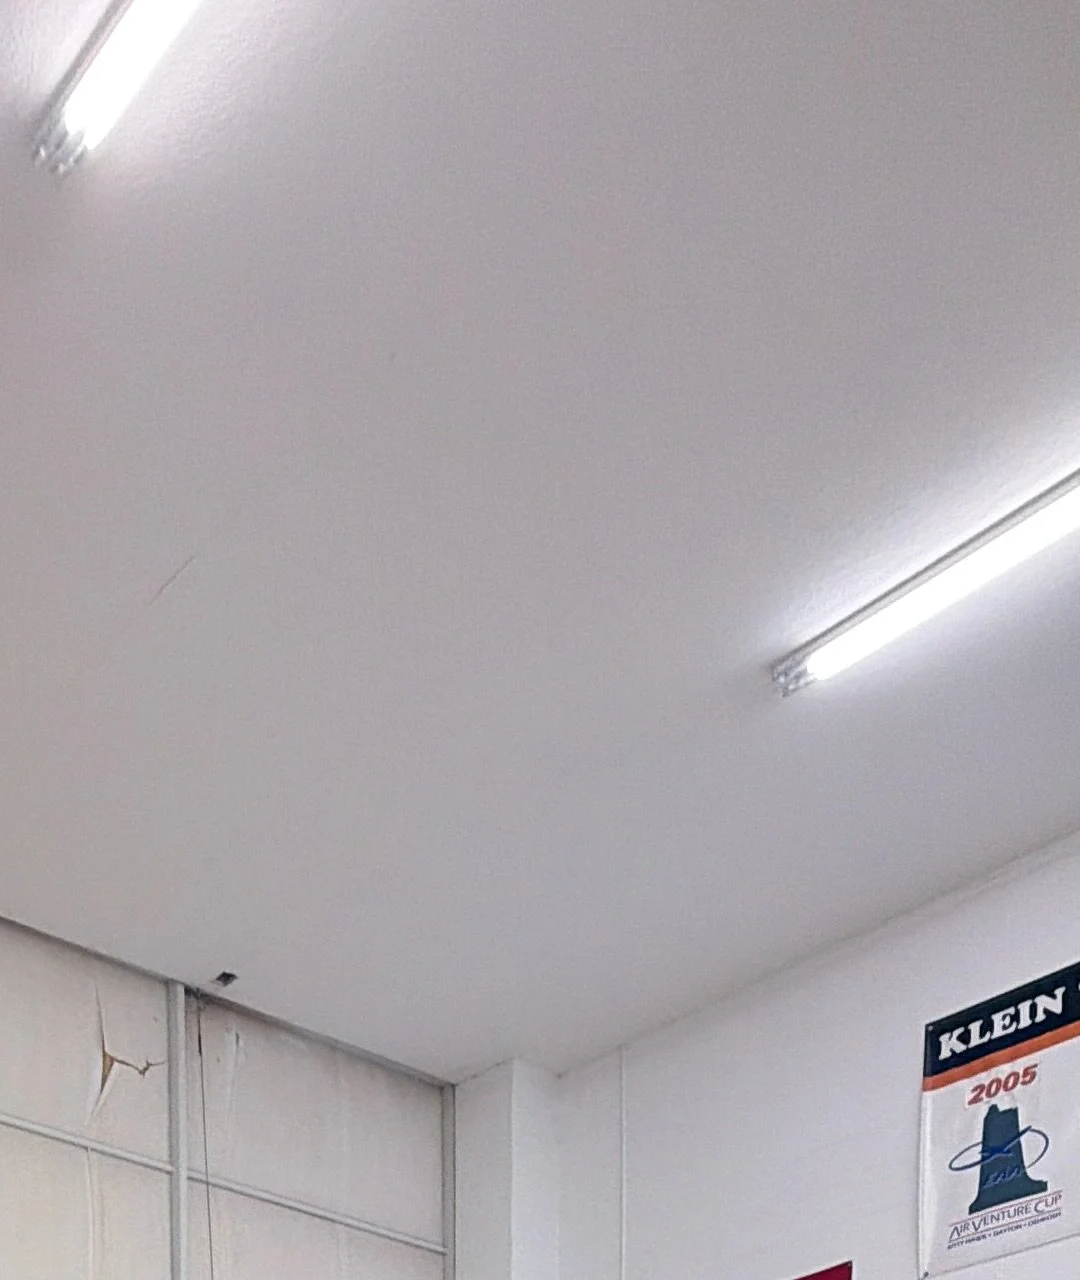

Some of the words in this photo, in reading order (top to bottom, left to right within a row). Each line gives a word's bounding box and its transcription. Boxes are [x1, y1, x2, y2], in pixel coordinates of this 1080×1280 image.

[938, 986, 1066, 1061] KLEIN
[967, 1064, 1038, 1106] 2005
[1034, 1194, 1062, 1214] CUP
